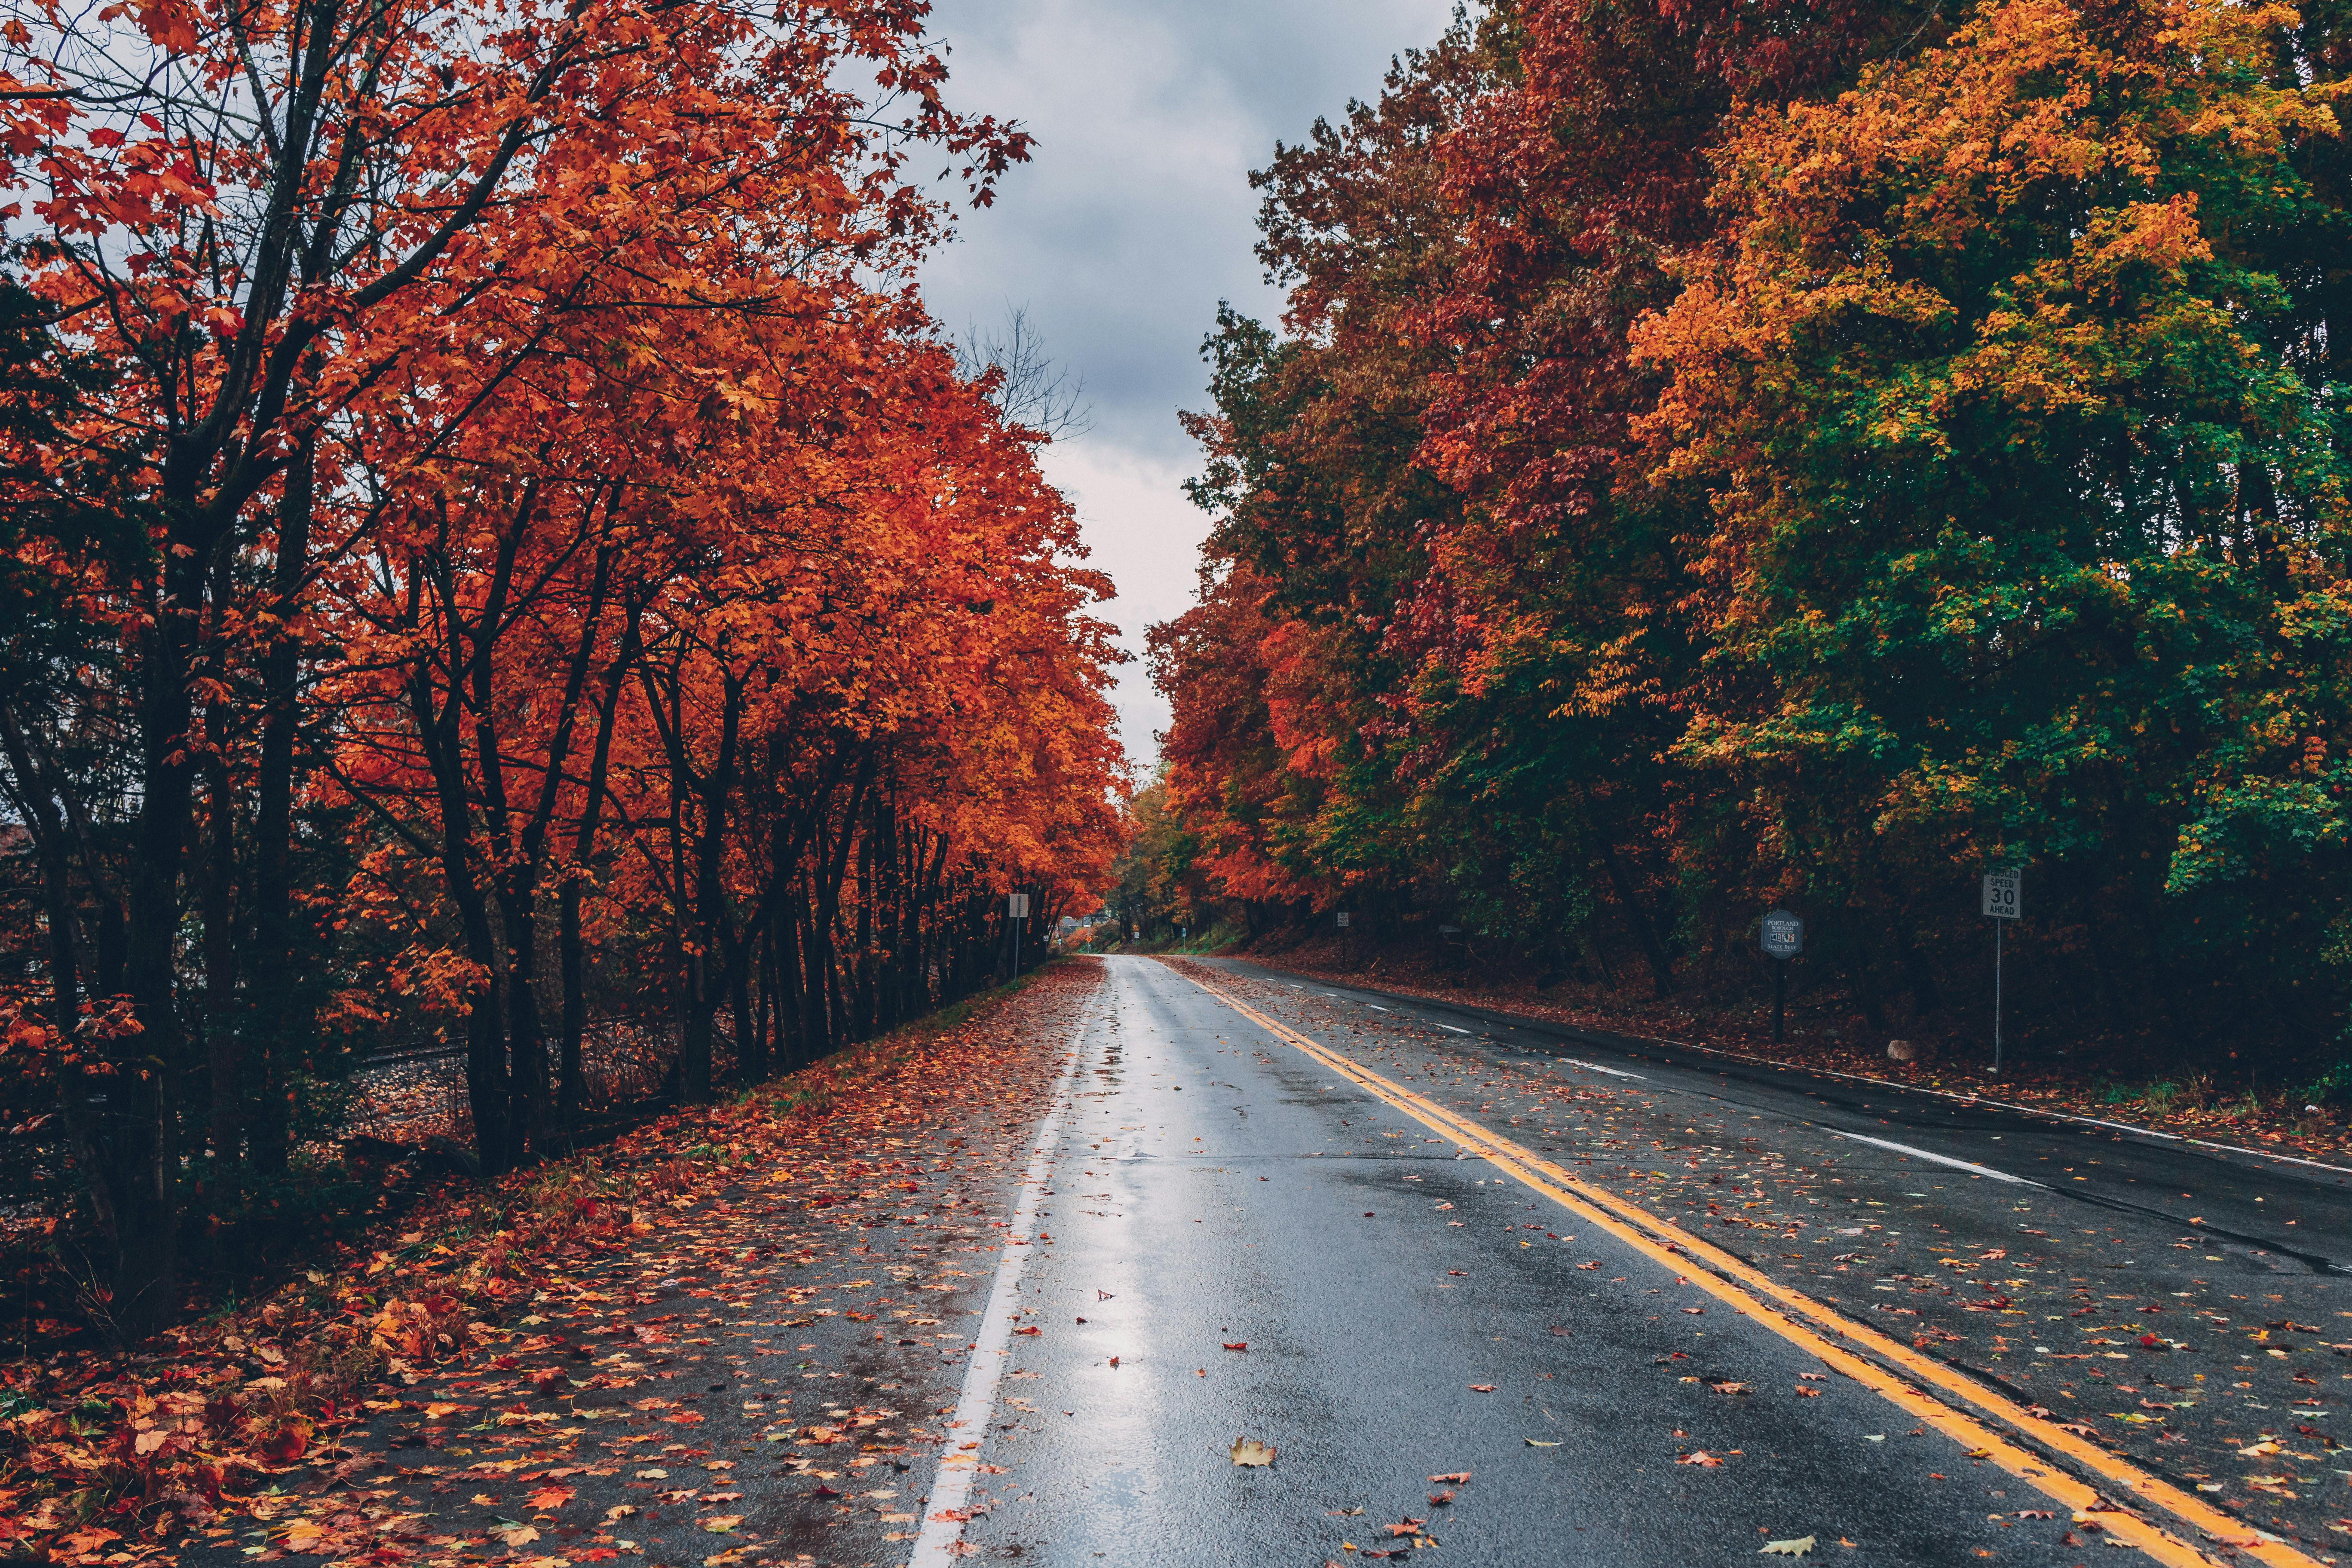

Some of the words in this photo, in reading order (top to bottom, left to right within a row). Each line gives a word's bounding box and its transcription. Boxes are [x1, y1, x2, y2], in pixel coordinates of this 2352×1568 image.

[1991, 878, 2014, 888] SPEED
[1991, 888, 2014, 905] 30
[1990, 905, 2014, 915] AHEAD
